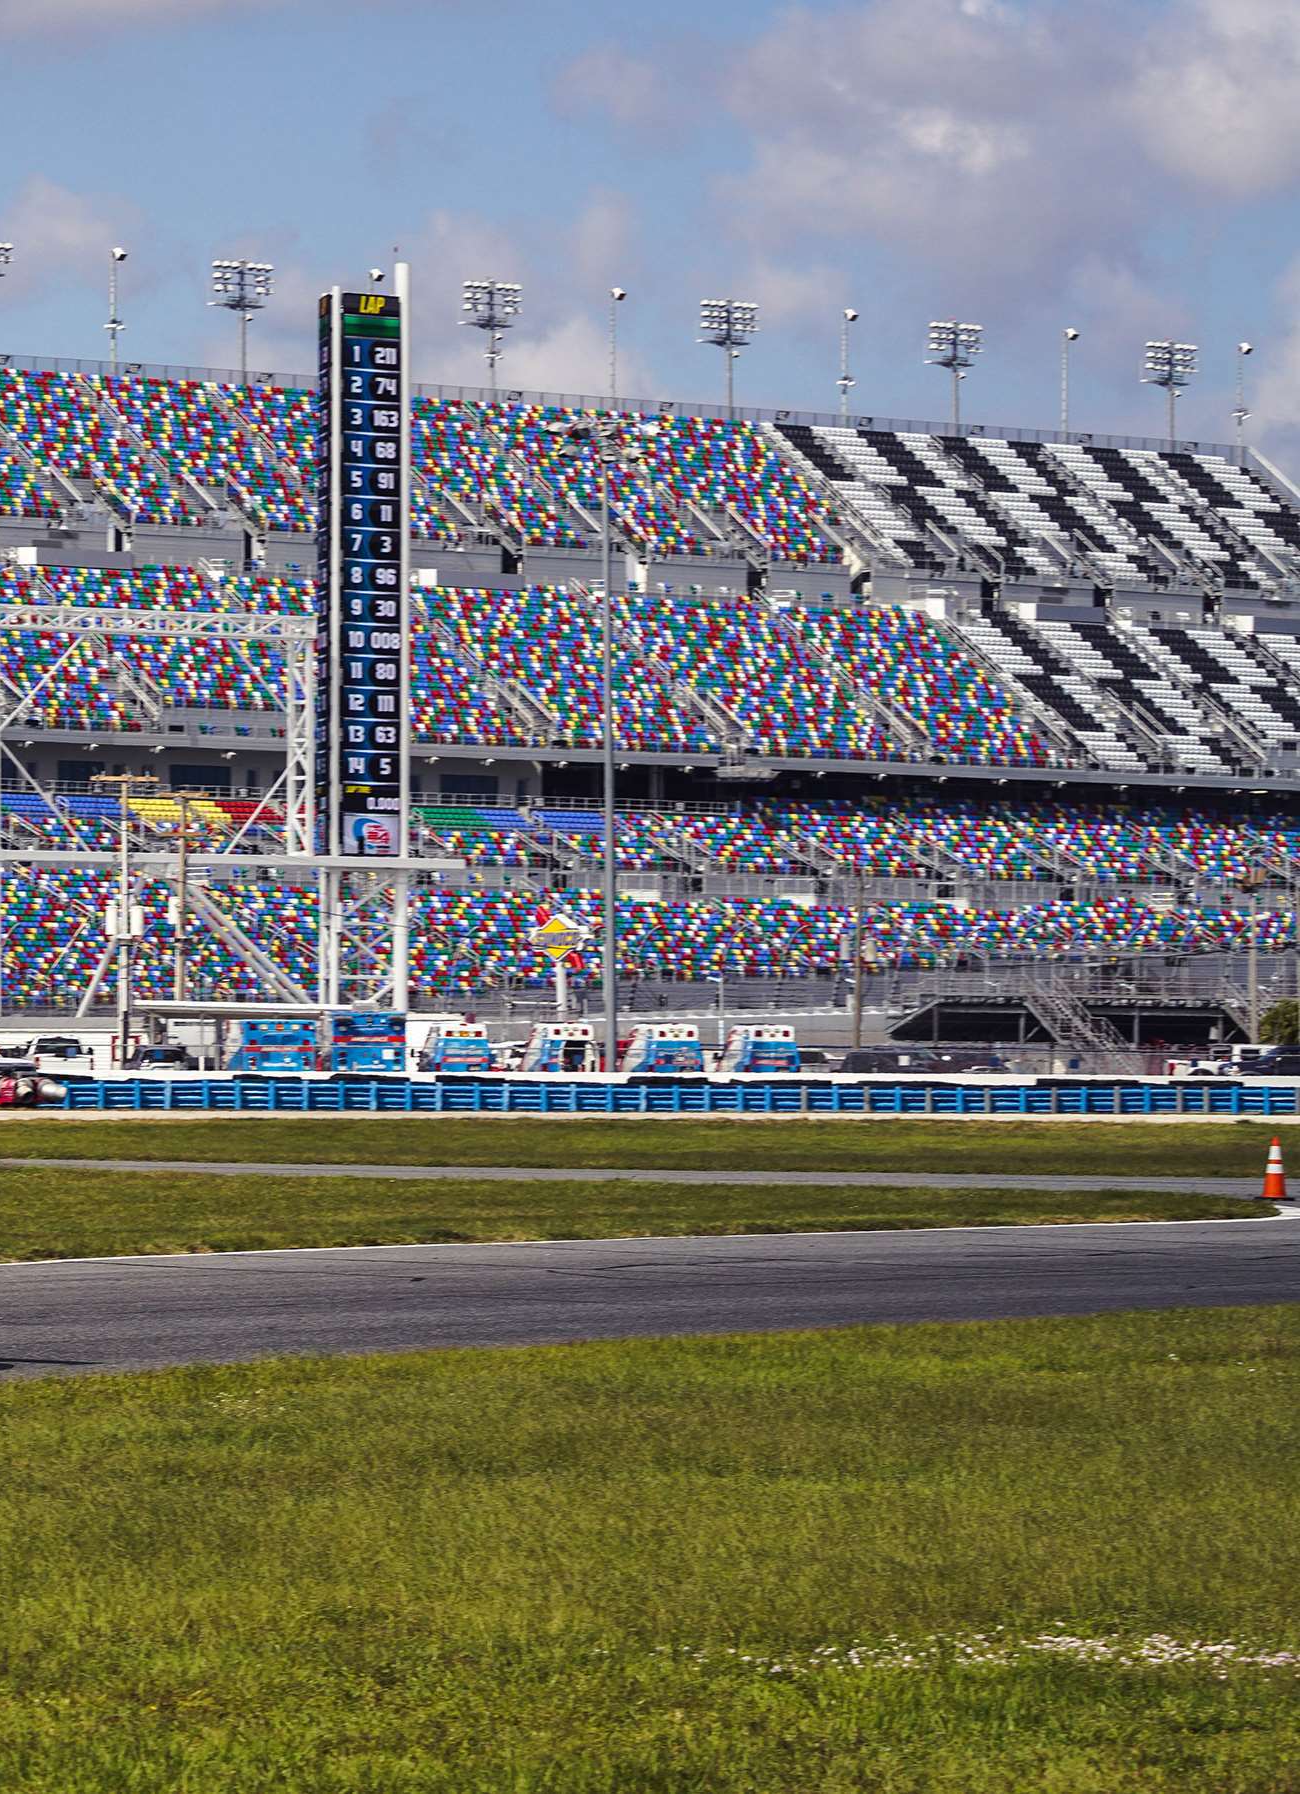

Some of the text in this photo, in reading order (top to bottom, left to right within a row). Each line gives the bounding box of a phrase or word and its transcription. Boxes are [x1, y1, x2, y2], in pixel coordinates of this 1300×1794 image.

[359, 295, 386, 314] LAP
[353, 345, 361, 362] 1
[350, 376, 397, 395] 2 74
[350, 408, 399, 427] 3 163
[350, 440, 397, 459] 4 68
[350, 471, 395, 490] 5 91
[351, 503, 393, 522] 6 11
[351, 534, 392, 553] 7 3
[350, 566, 397, 585] 8 96
[350, 598, 397, 617] 9 30
[348, 630, 365, 648] 10
[350, 661, 397, 680] 11 80
[348, 693, 365, 711] 12
[348, 725, 397, 744] 13 63
[348, 756, 392, 775] 14 5
